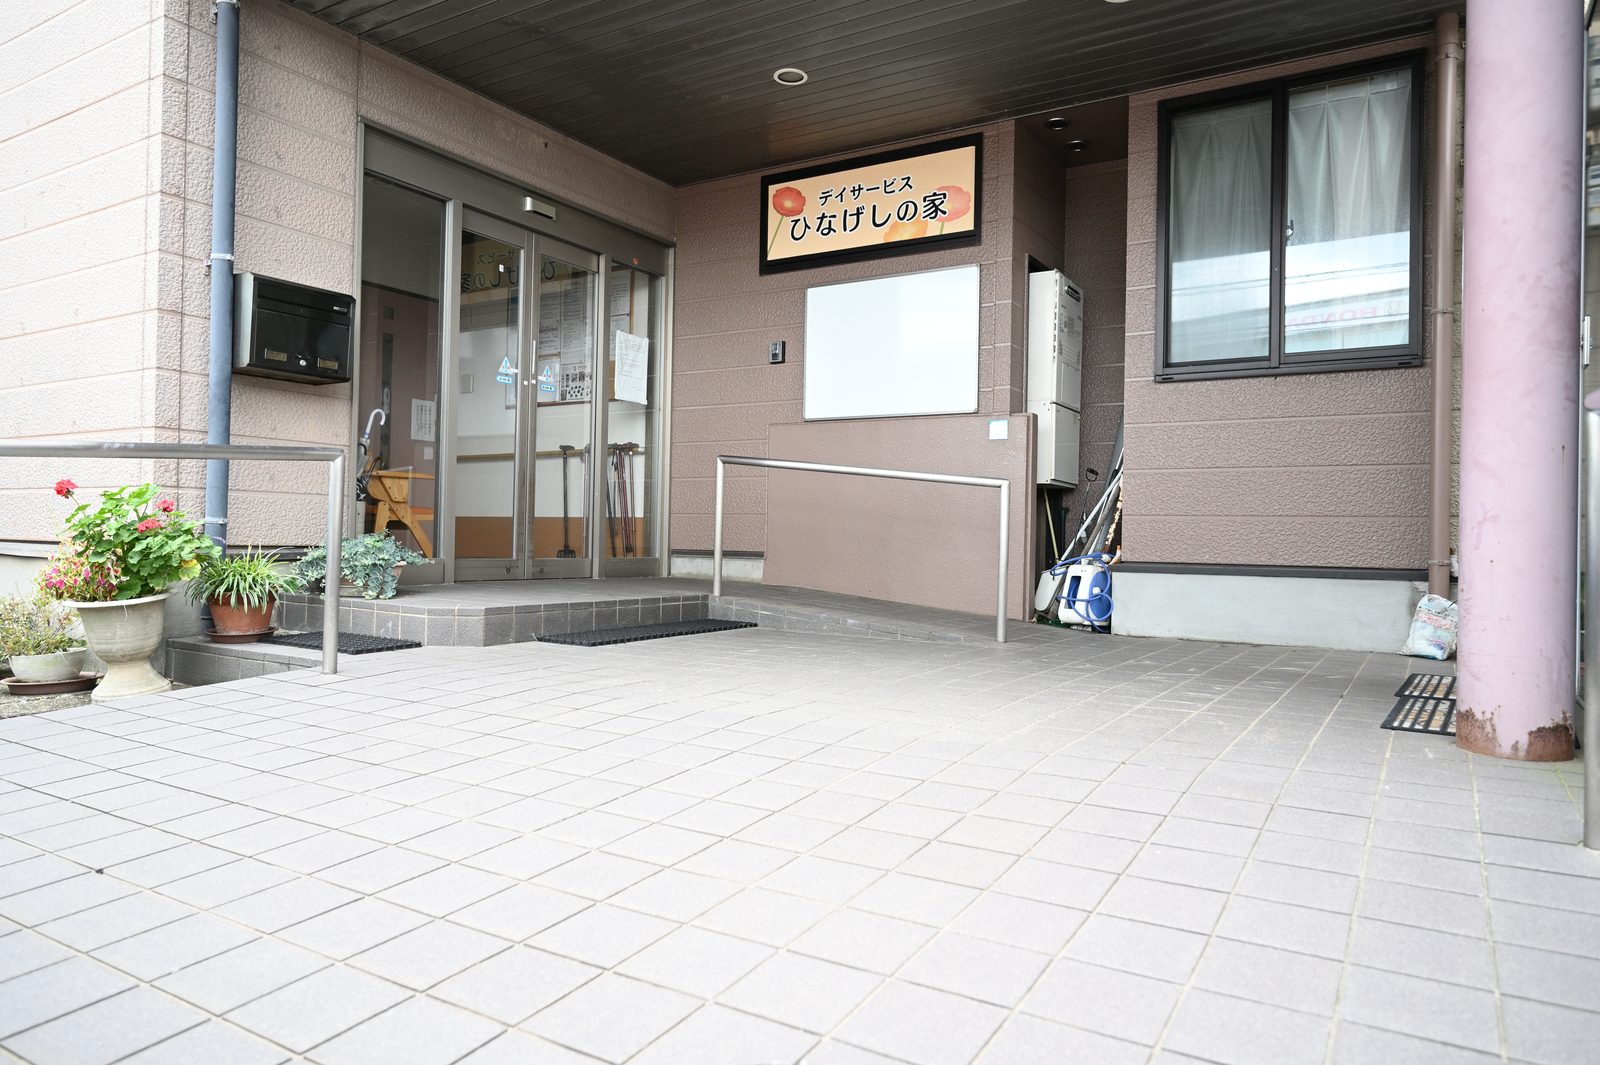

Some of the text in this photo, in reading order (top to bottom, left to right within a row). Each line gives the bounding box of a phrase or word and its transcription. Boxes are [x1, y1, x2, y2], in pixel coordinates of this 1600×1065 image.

[819, 176, 913, 206] デイサービス
[790, 191, 948, 241] ひなげしの家
